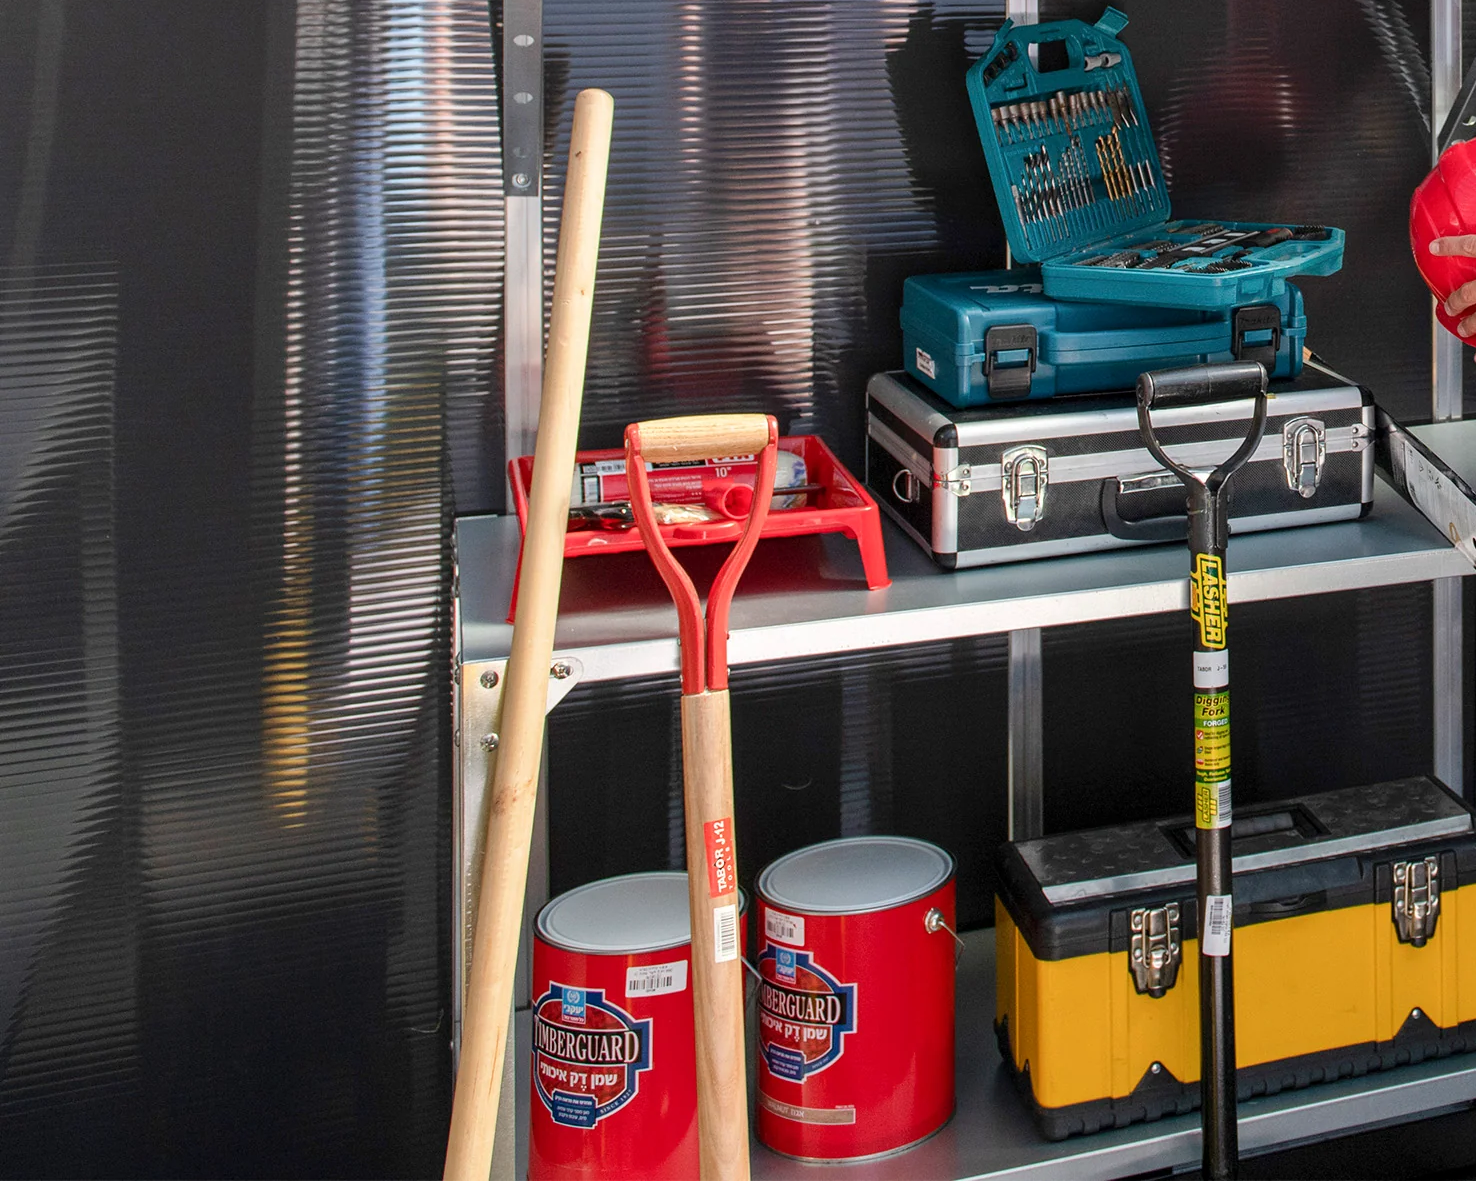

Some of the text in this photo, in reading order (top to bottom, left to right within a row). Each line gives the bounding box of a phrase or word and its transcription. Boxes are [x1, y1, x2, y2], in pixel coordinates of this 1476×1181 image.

[1201, 560, 1222, 643] LASHER
[1196, 695, 1229, 707] Diggin
[1201, 706, 1225, 717] Fork
[713, 820, 727, 893] TABOR J-12
[534, 1014, 640, 1063] TIMBERGUARD
[803, 1026, 828, 1042] שמן
[540, 1061, 567, 1082] איכותי
[590, 1073, 618, 1089] שמן
